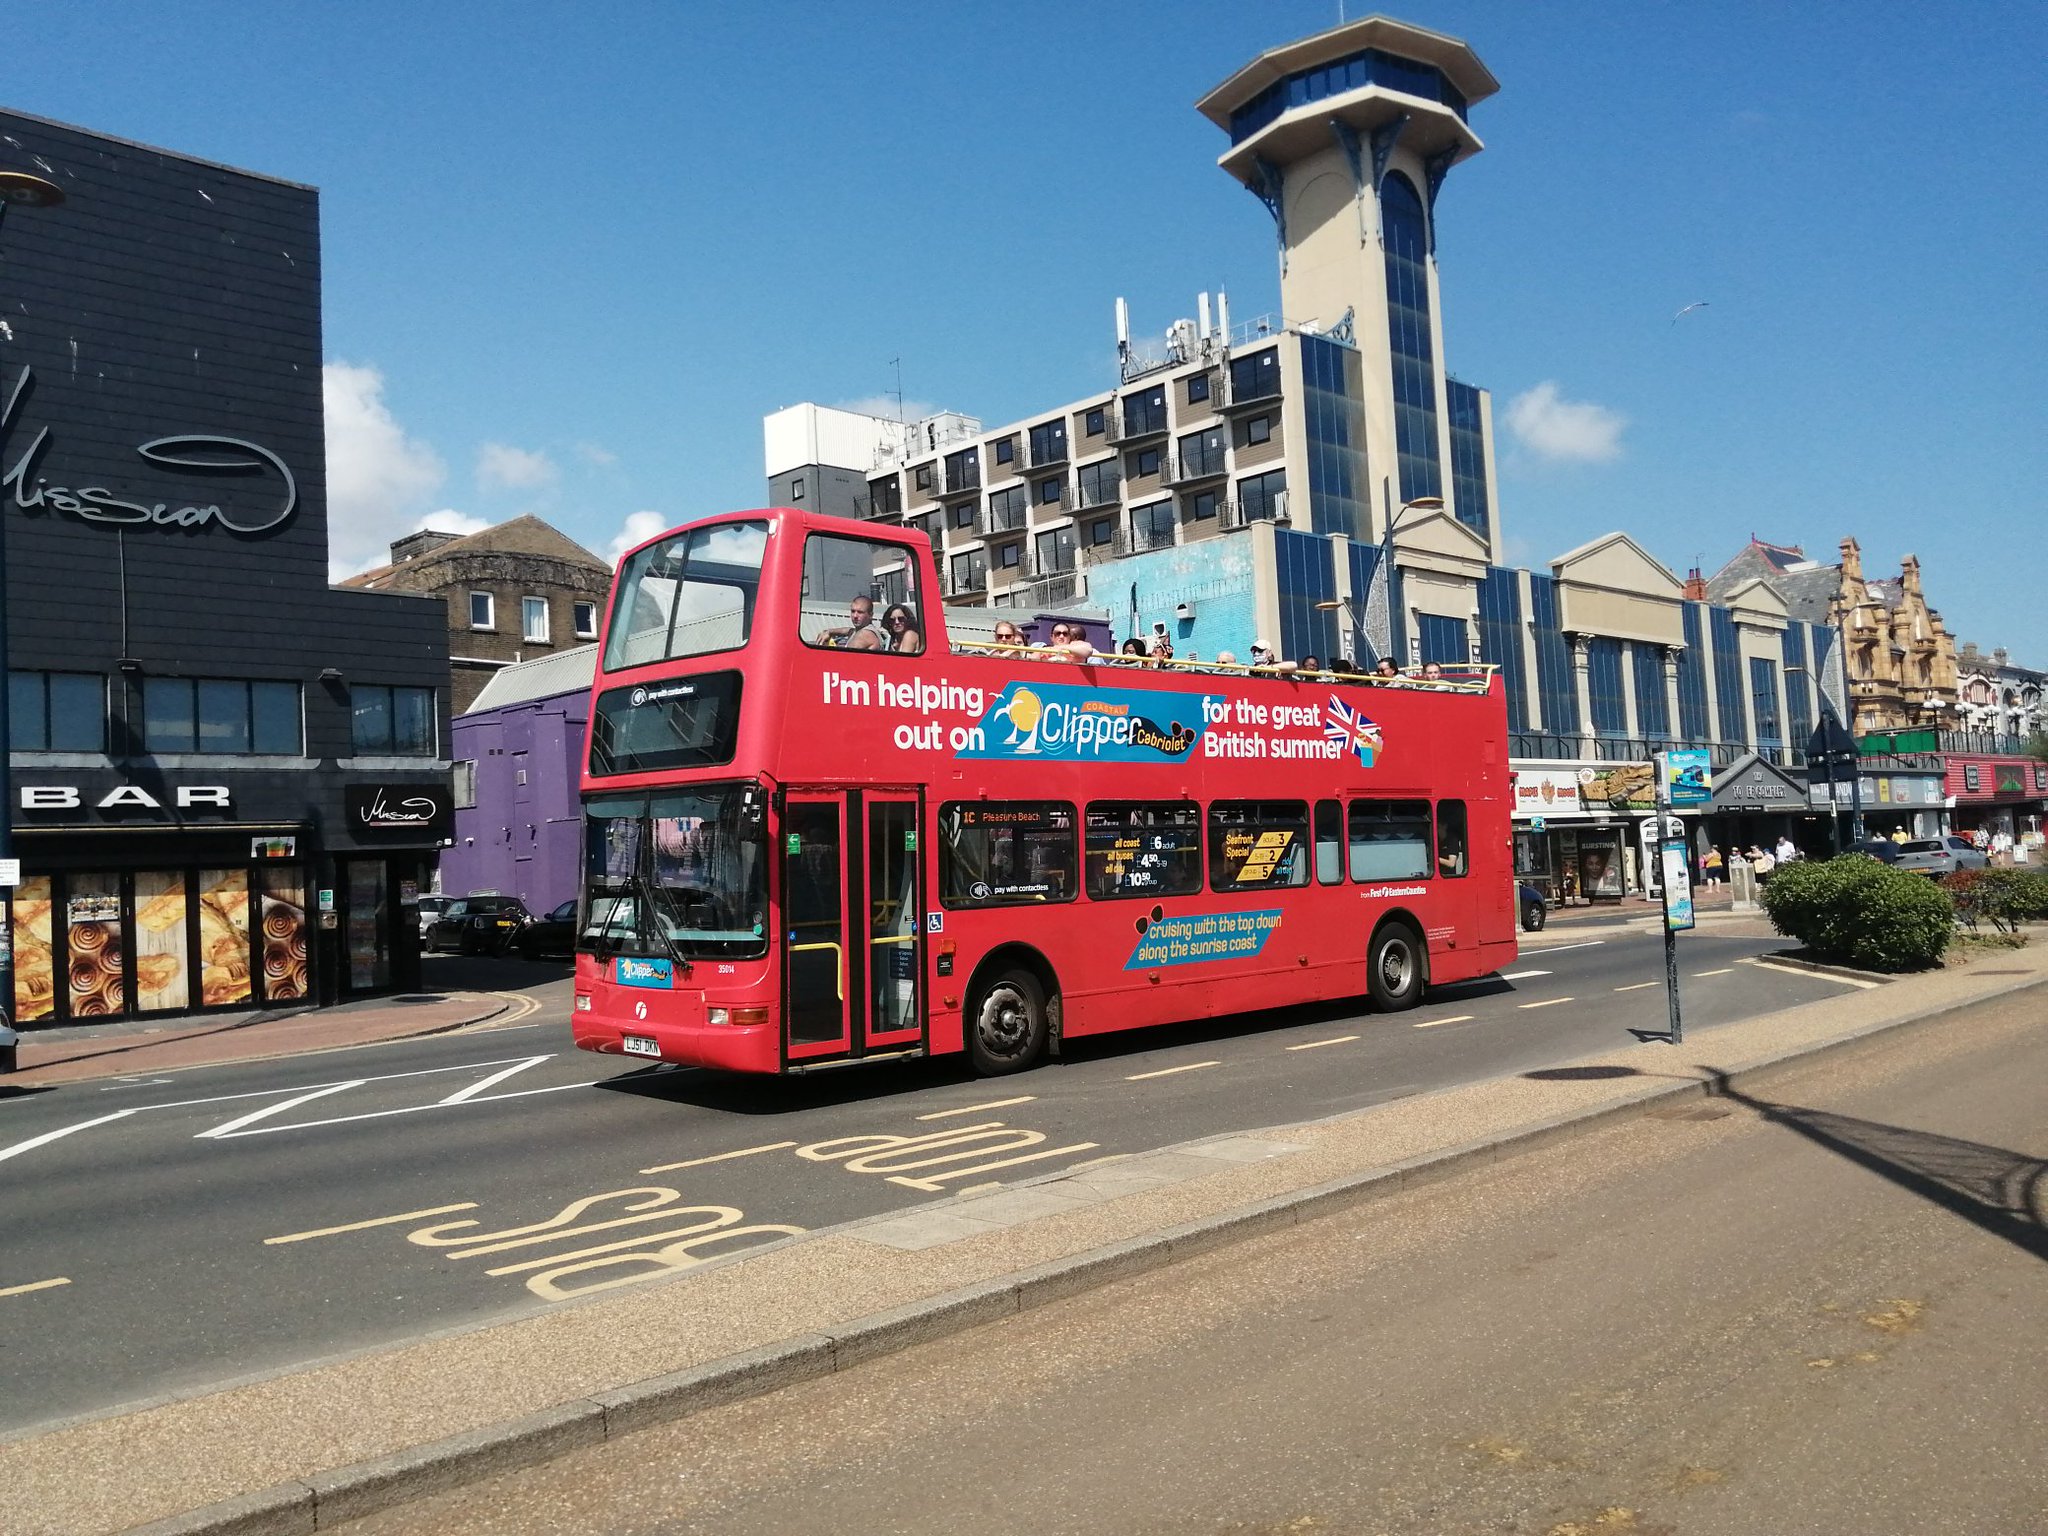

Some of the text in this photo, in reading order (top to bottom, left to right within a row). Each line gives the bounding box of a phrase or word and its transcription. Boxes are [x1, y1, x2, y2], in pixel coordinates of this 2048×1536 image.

[823, 671, 983, 717] I'm helping
[1086, 703, 1124, 715] COASTAL
[1202, 696, 1320, 730] for the great
[894, 721, 985, 750] out on
[1041, 703, 1142, 755] Clipper
[1137, 728, 1186, 751] Cabriolet
[1204, 731, 1344, 759] British summer
[21, 786, 230, 808] BAR
[963, 812, 1041, 824] 1C Pleasure Beach
[1115, 838, 1140, 848] all coast
[1226, 833, 1254, 845] Seafront
[1107, 852, 1115, 861] all
[1226, 847, 1249, 860] Special
[1105, 864, 1113, 874] all
[1006, 885, 1018, 893] with
[1019, 884, 1049, 892] contactless
[1149, 912, 1282, 940] cruising with the top down
[1138, 934, 1257, 964] along the sunrise coast
[718, 964, 735, 974] 35014
[795, 1121, 1101, 1198] TOP
[407, 1187, 809, 1301] BUS
